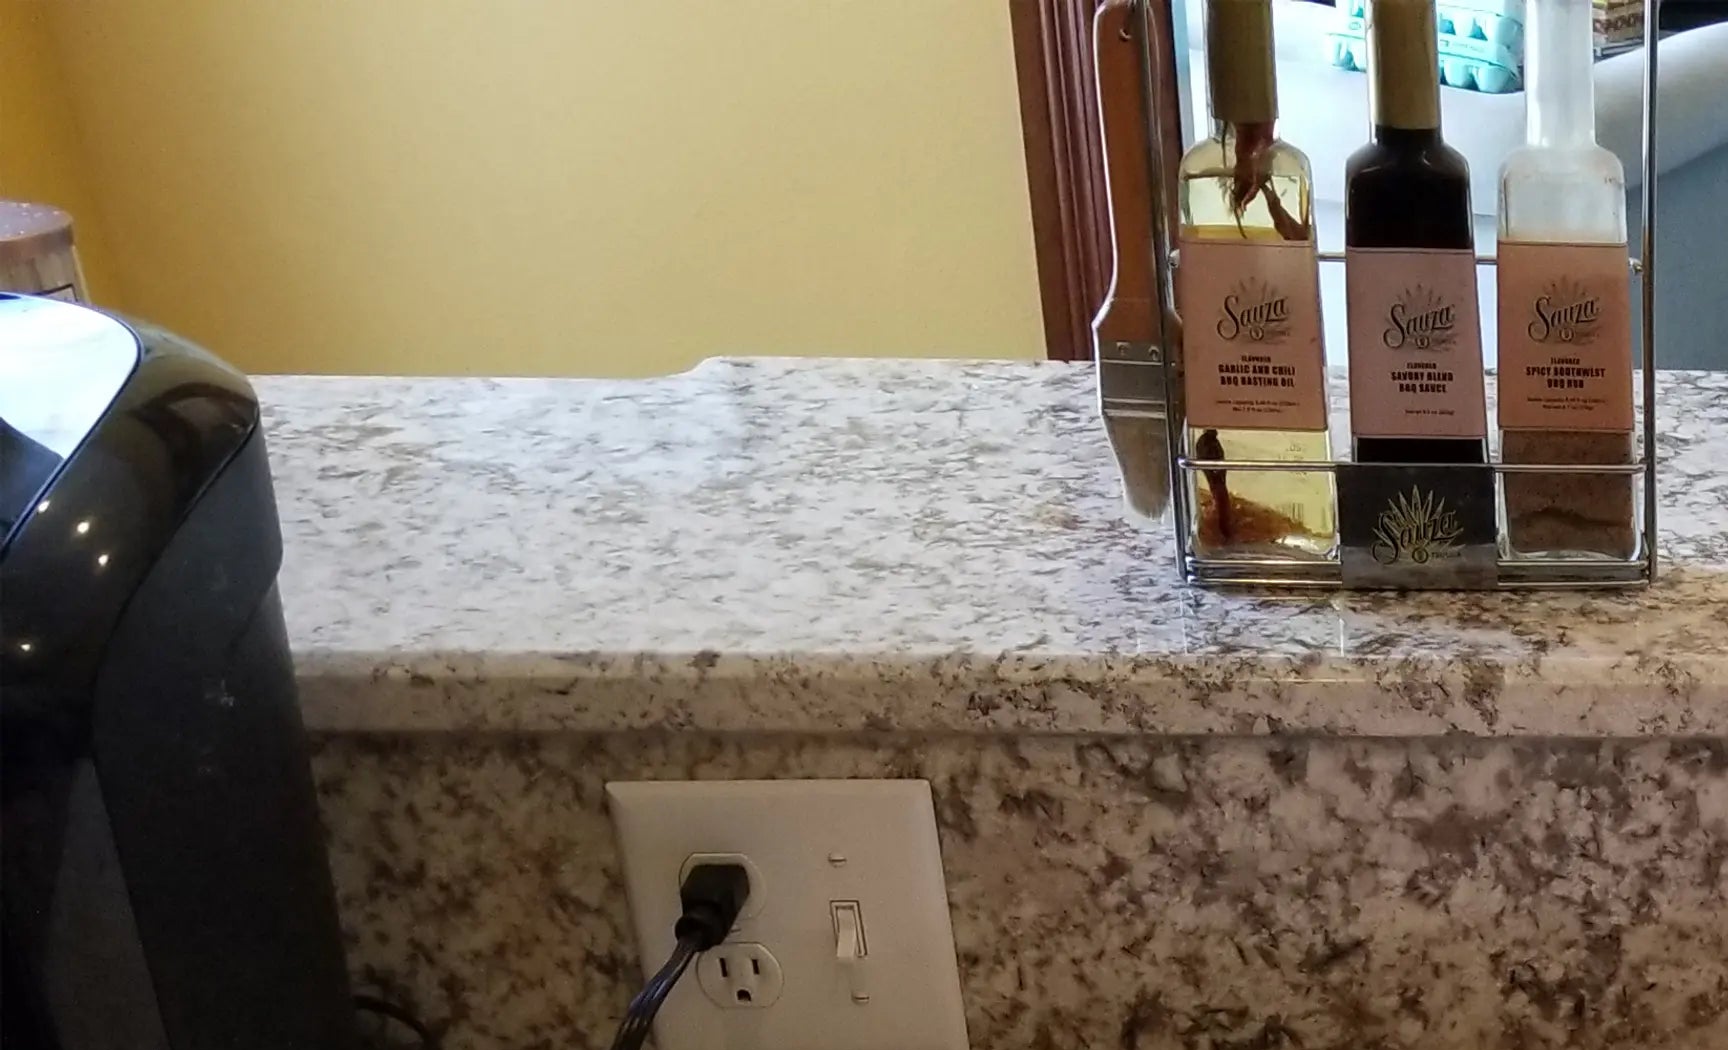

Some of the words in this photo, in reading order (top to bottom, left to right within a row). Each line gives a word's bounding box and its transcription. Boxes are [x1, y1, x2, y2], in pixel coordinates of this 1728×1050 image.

[1216, 294, 1289, 341] Sauza
[1527, 296, 1600, 342] Sauza
[1383, 303, 1456, 349] Sauza
[1218, 364, 1250, 374] GARLIC
[1252, 365, 1270, 375] AND
[1526, 366, 1551, 376] SPICY
[1553, 367, 1606, 377] SOUTHWEST
[1220, 376, 1239, 387] BBQ
[1241, 376, 1279, 387] BASTING
[1281, 378, 1295, 388] OIL
[1391, 371, 1425, 381] SAVORY
[1427, 372, 1454, 382] BLEND
[1399, 383, 1417, 393] BBQ
[1419, 383, 1447, 393] SAUCE
[1547, 378, 1565, 388] BBQ
[1567, 379, 1584, 388] RUB
[1370, 510, 1464, 565] Sauza
